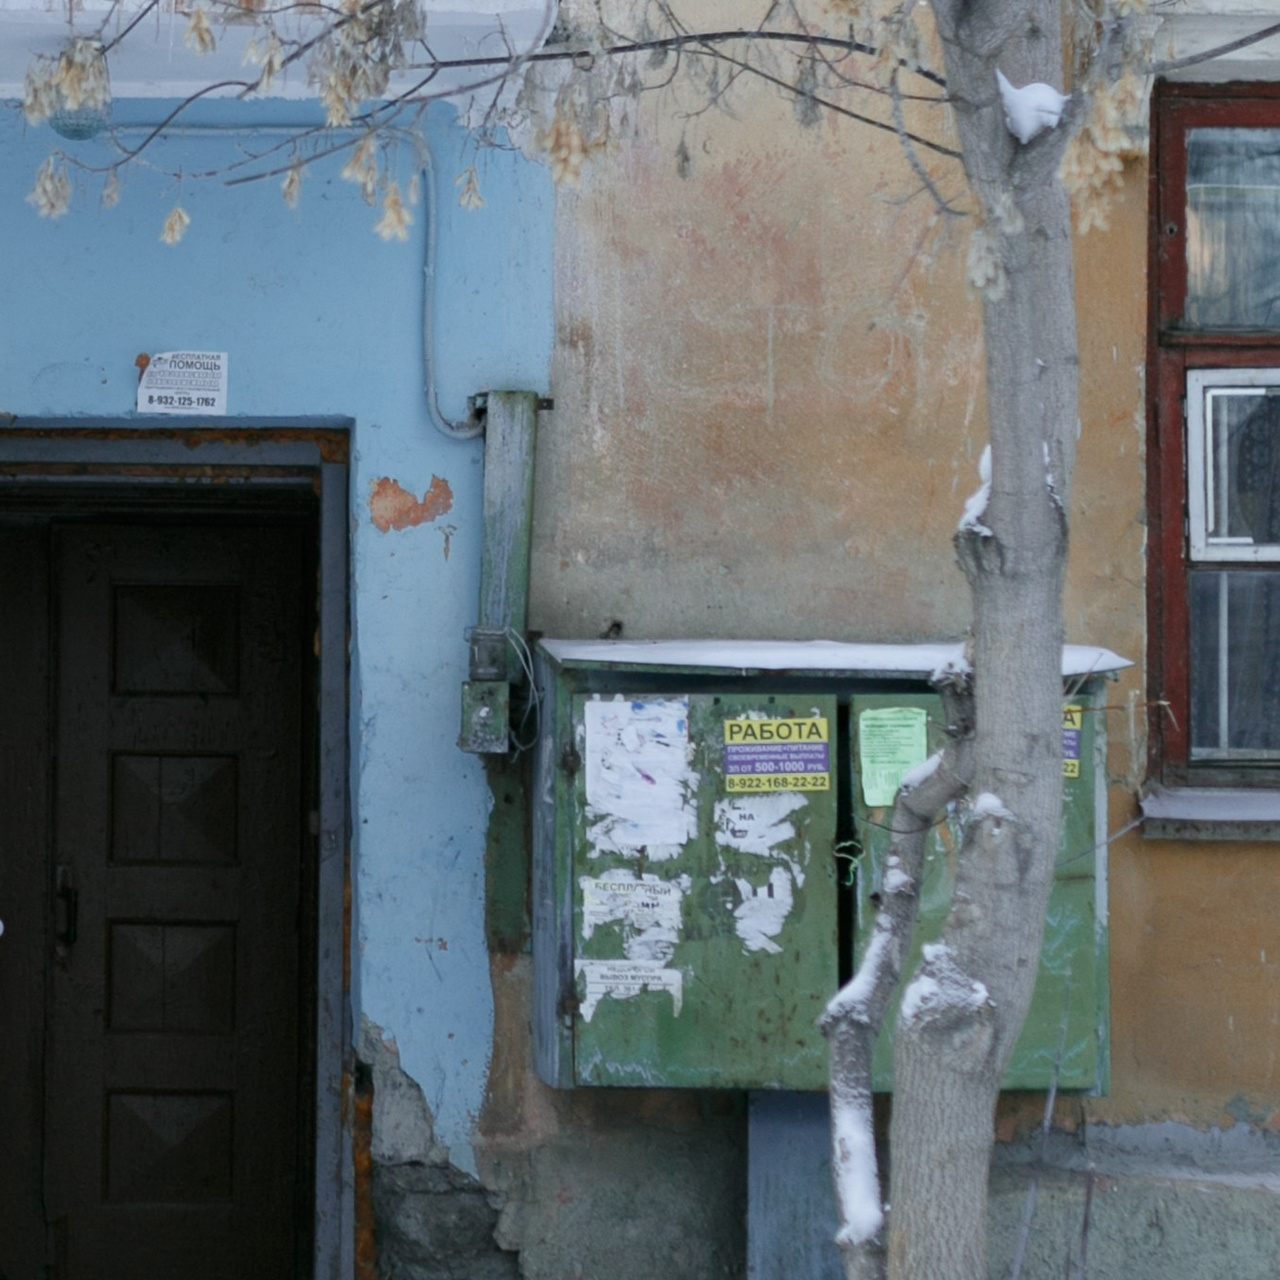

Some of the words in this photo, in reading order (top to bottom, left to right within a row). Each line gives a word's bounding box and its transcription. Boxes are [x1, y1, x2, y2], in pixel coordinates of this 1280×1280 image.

[169, 360, 221, 371] ПОМОЩЬ
[148, 394, 216, 407] 8-932-125-1762
[729, 722, 823, 741] РАБОТА
[741, 764, 753, 772] ОТ
[755, 762, 805, 772] 500-1000
[728, 776, 827, 789] 8-922-168-22-22
[739, 813, 755, 821] НА
[600, 973, 629, 981] ВЫВОЗ
[630, 974, 663, 982] МУСОРА
